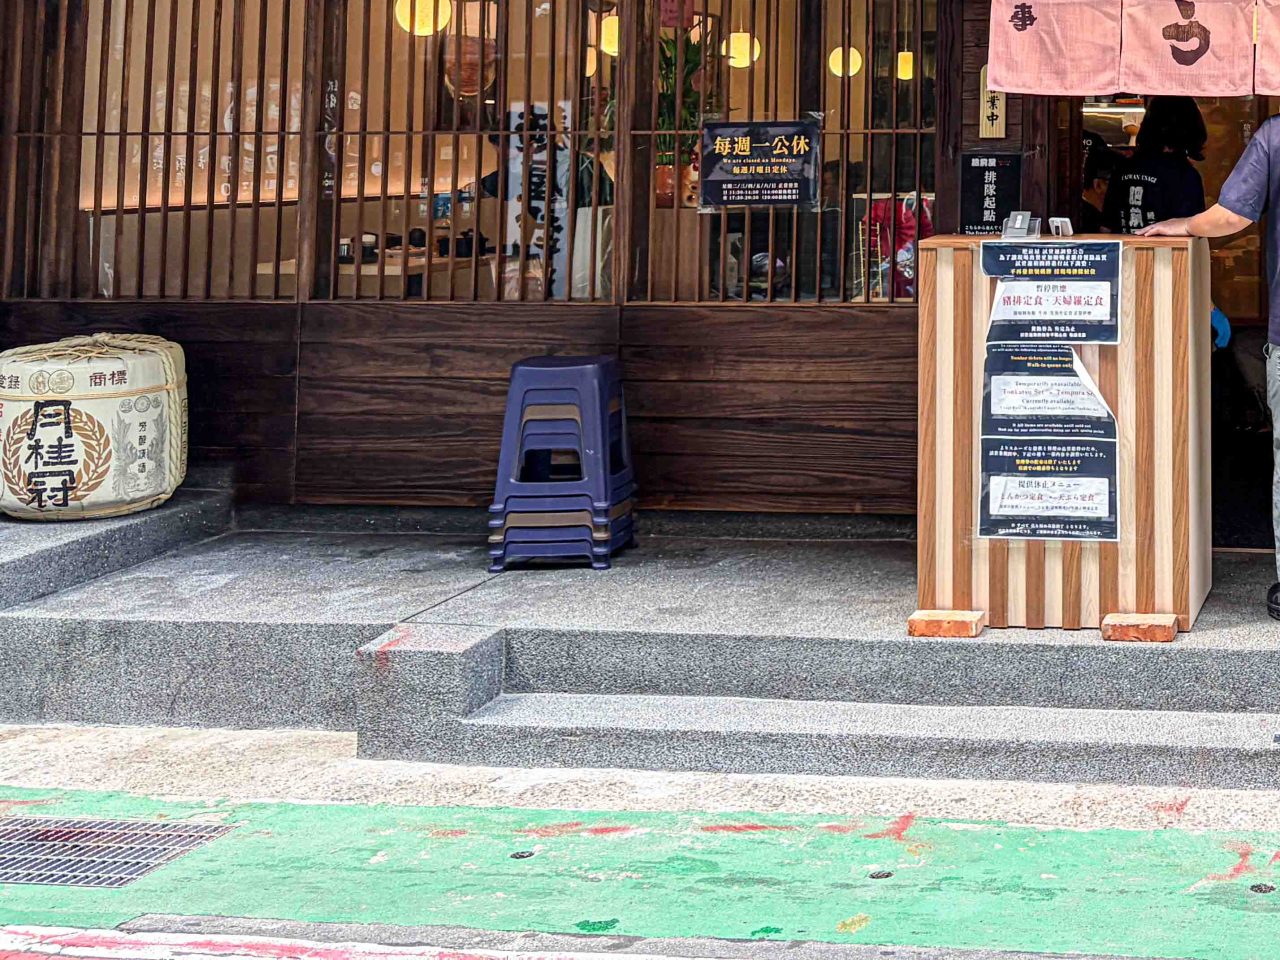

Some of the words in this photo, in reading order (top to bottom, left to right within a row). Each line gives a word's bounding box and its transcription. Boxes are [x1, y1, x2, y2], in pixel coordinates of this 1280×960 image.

[986, 90, 1000, 127] 業中
[713, 135, 810, 156] 每週一公休
[983, 170, 997, 222] 排隊起點
[89, 369, 128, 387] 商標
[24, 399, 79, 508] 月桂冠
